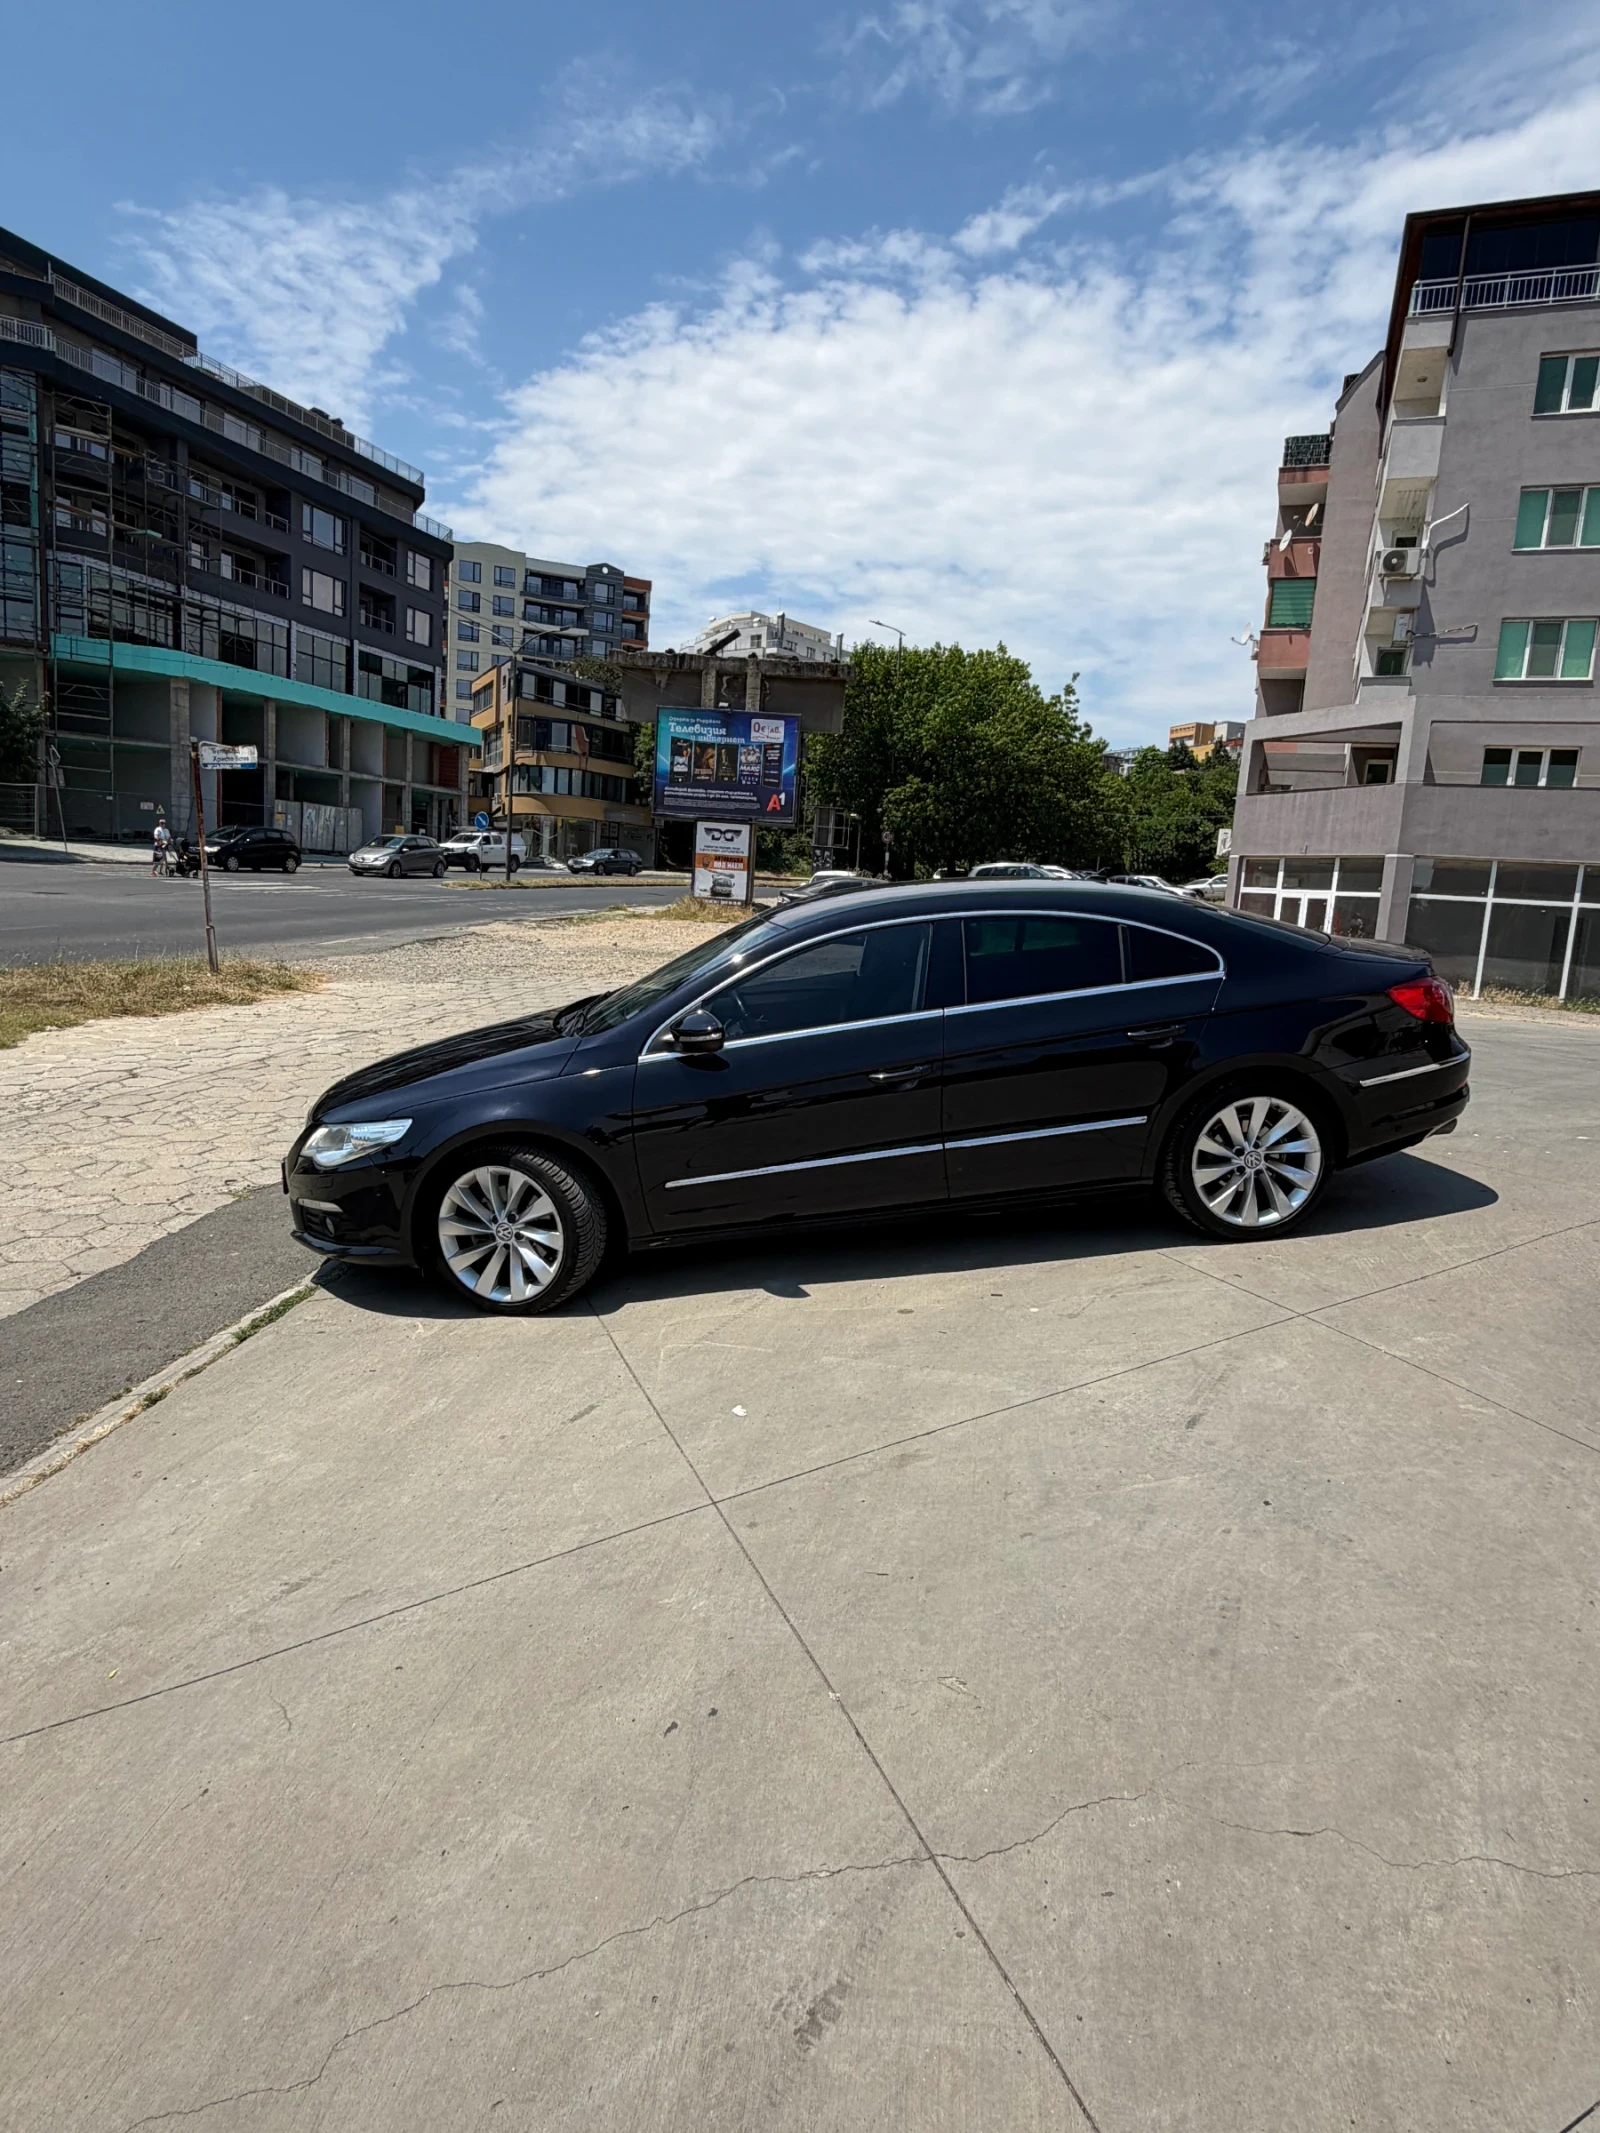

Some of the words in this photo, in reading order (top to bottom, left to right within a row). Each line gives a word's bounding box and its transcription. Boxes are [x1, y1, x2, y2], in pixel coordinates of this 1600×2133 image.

[668, 722, 727, 736] Телевизия
[699, 735, 746, 745] интернет
[766, 792, 786, 812] A1
[713, 861, 727, 869] ПОД
